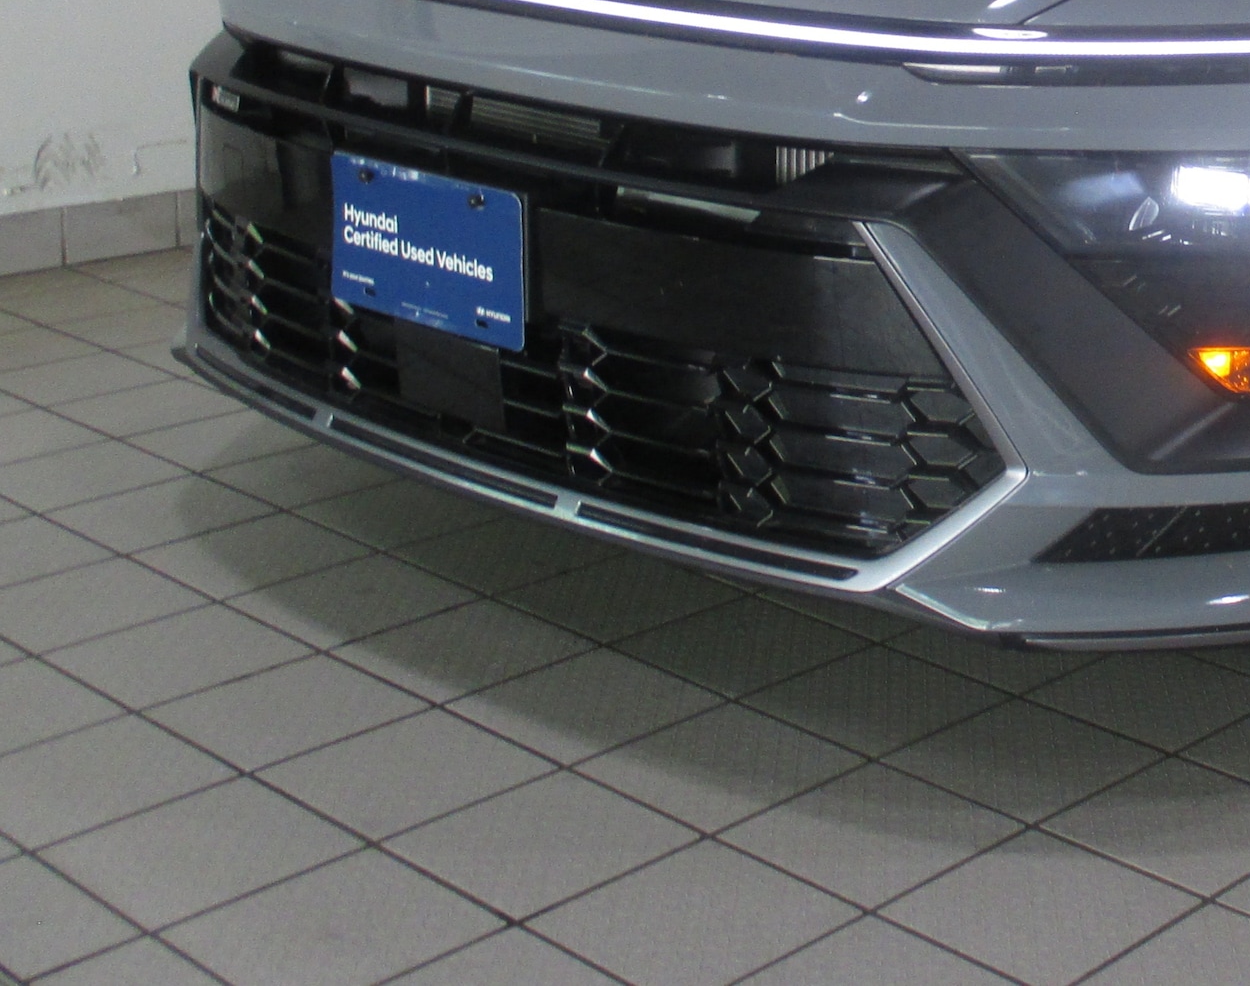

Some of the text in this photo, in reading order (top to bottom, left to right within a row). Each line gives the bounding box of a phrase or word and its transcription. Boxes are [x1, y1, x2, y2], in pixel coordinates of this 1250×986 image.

[344, 202, 398, 234] Hyundai
[344, 225, 494, 282] Certified Used Vehicles
